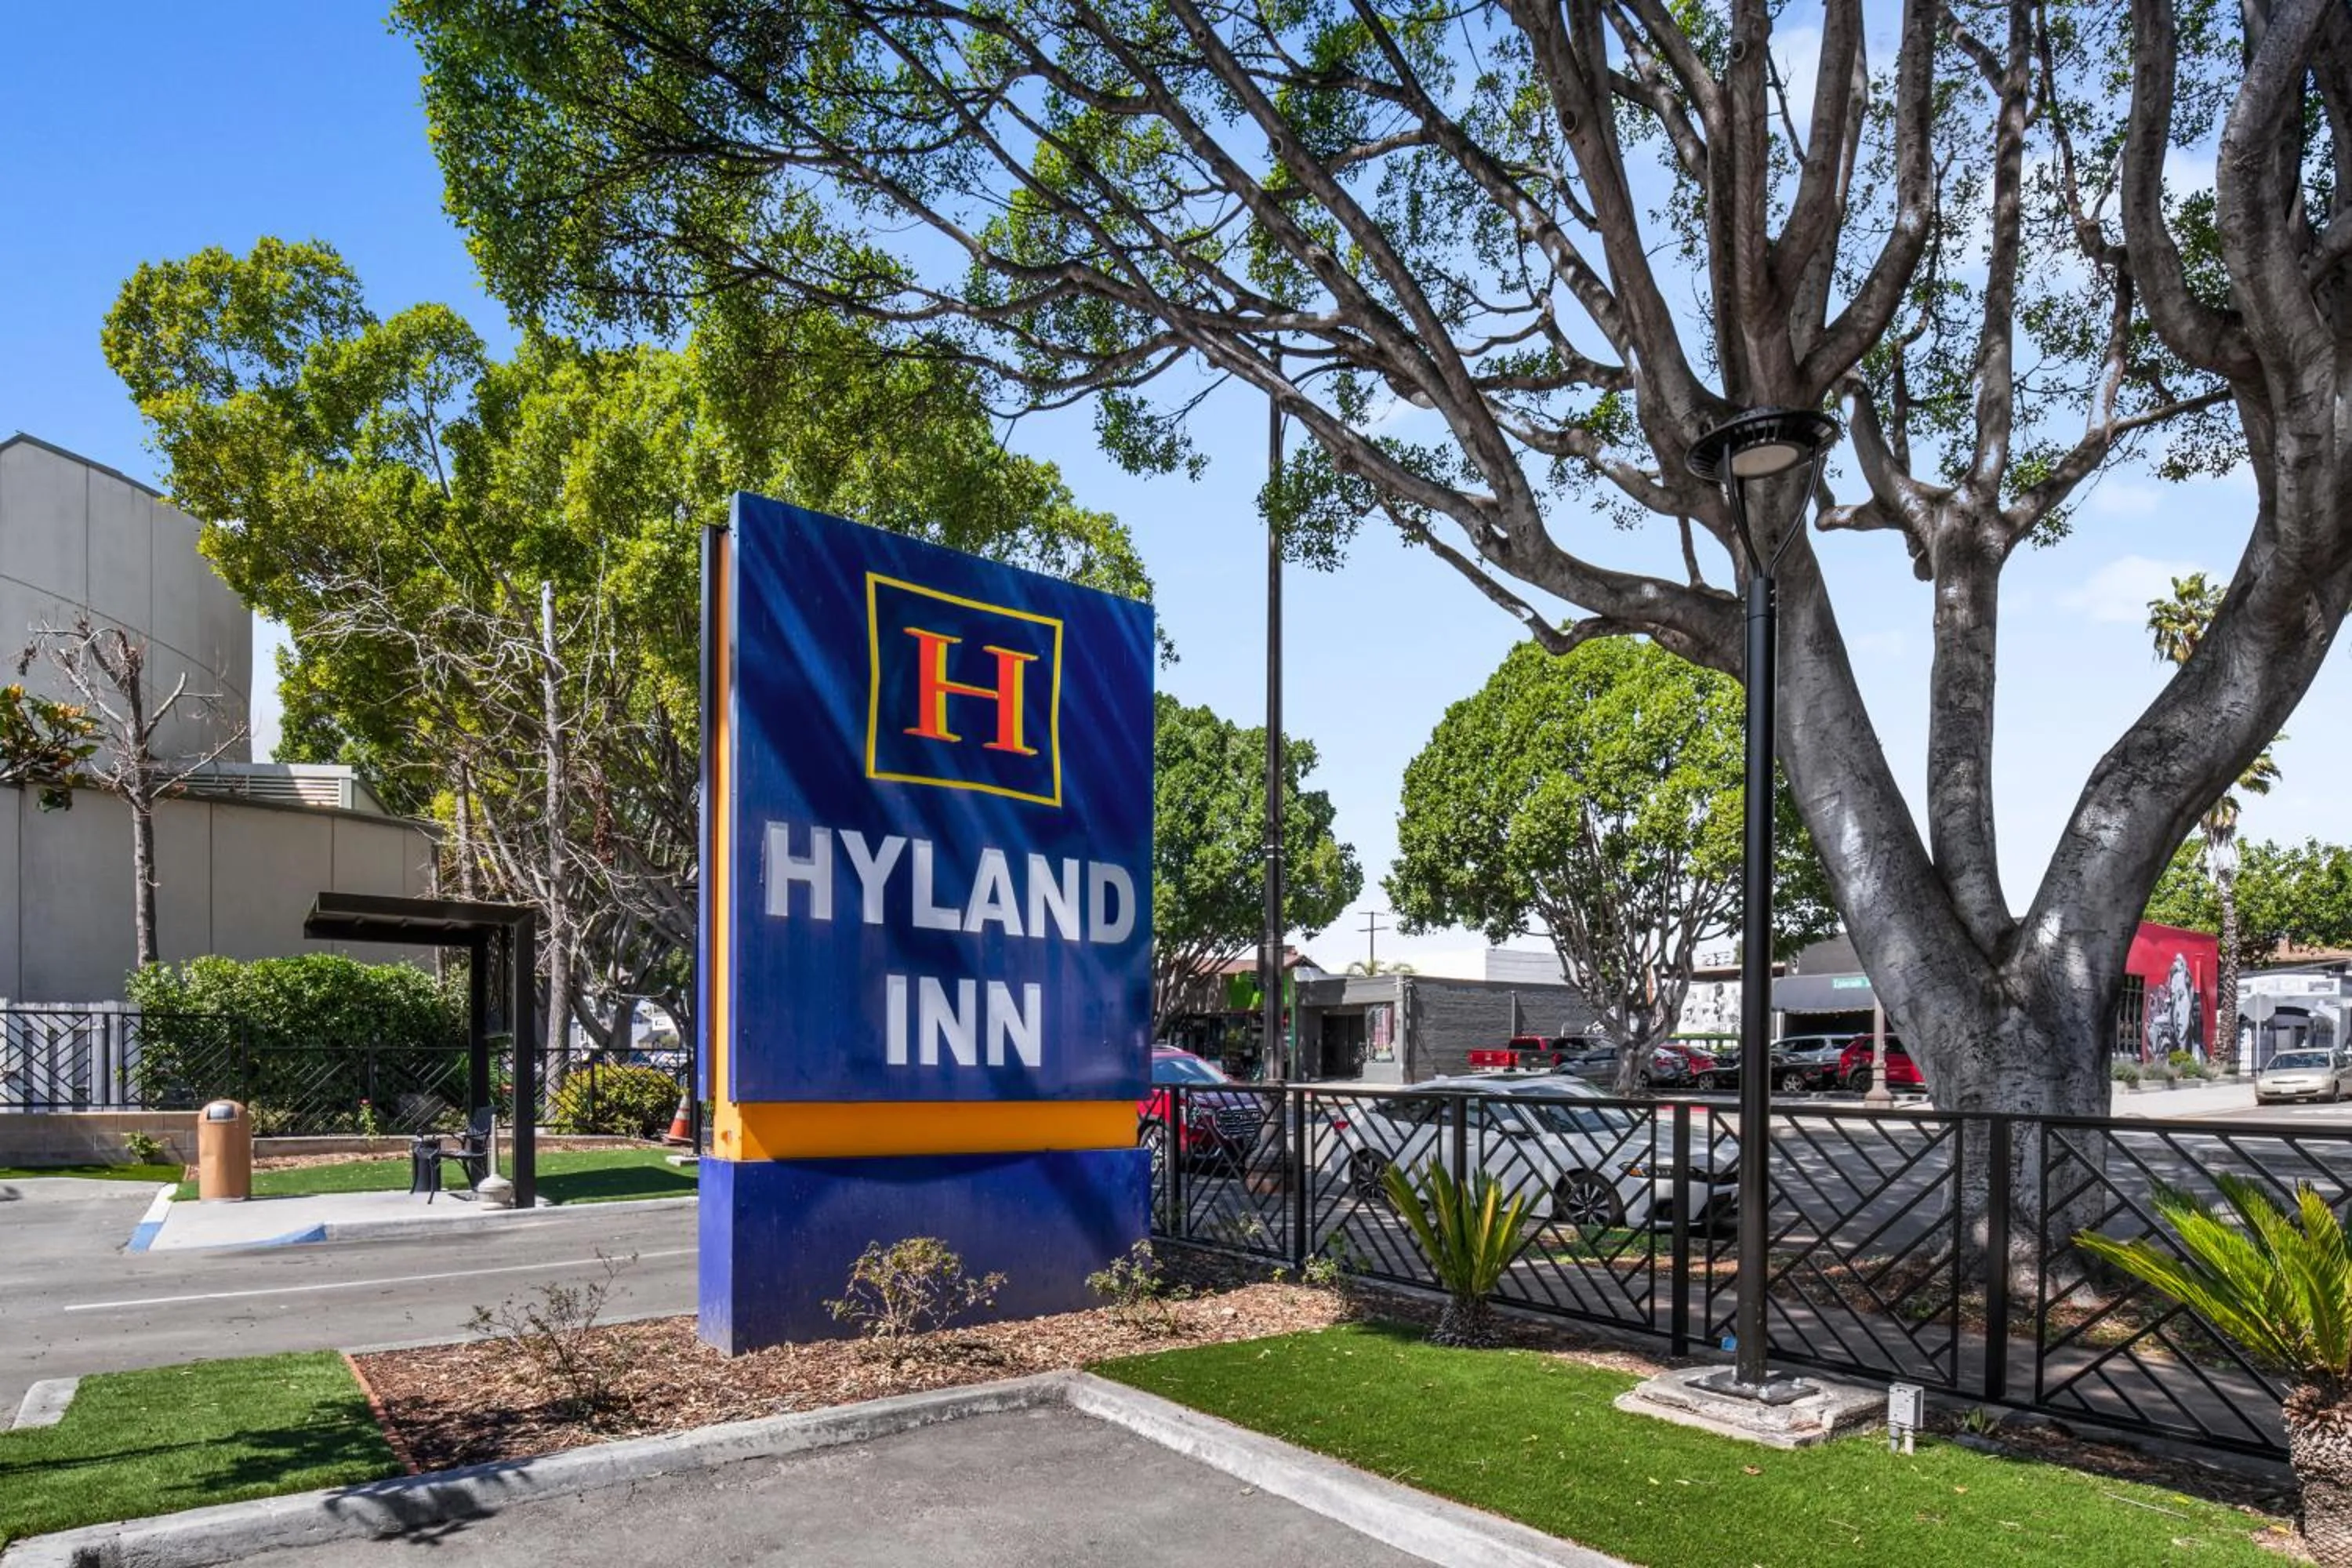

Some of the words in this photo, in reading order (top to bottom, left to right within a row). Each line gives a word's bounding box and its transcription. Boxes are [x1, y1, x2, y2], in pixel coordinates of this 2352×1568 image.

[903, 626, 1039, 756] H
[765, 821, 1135, 943] HYLAND
[886, 975, 1042, 1066] INN
